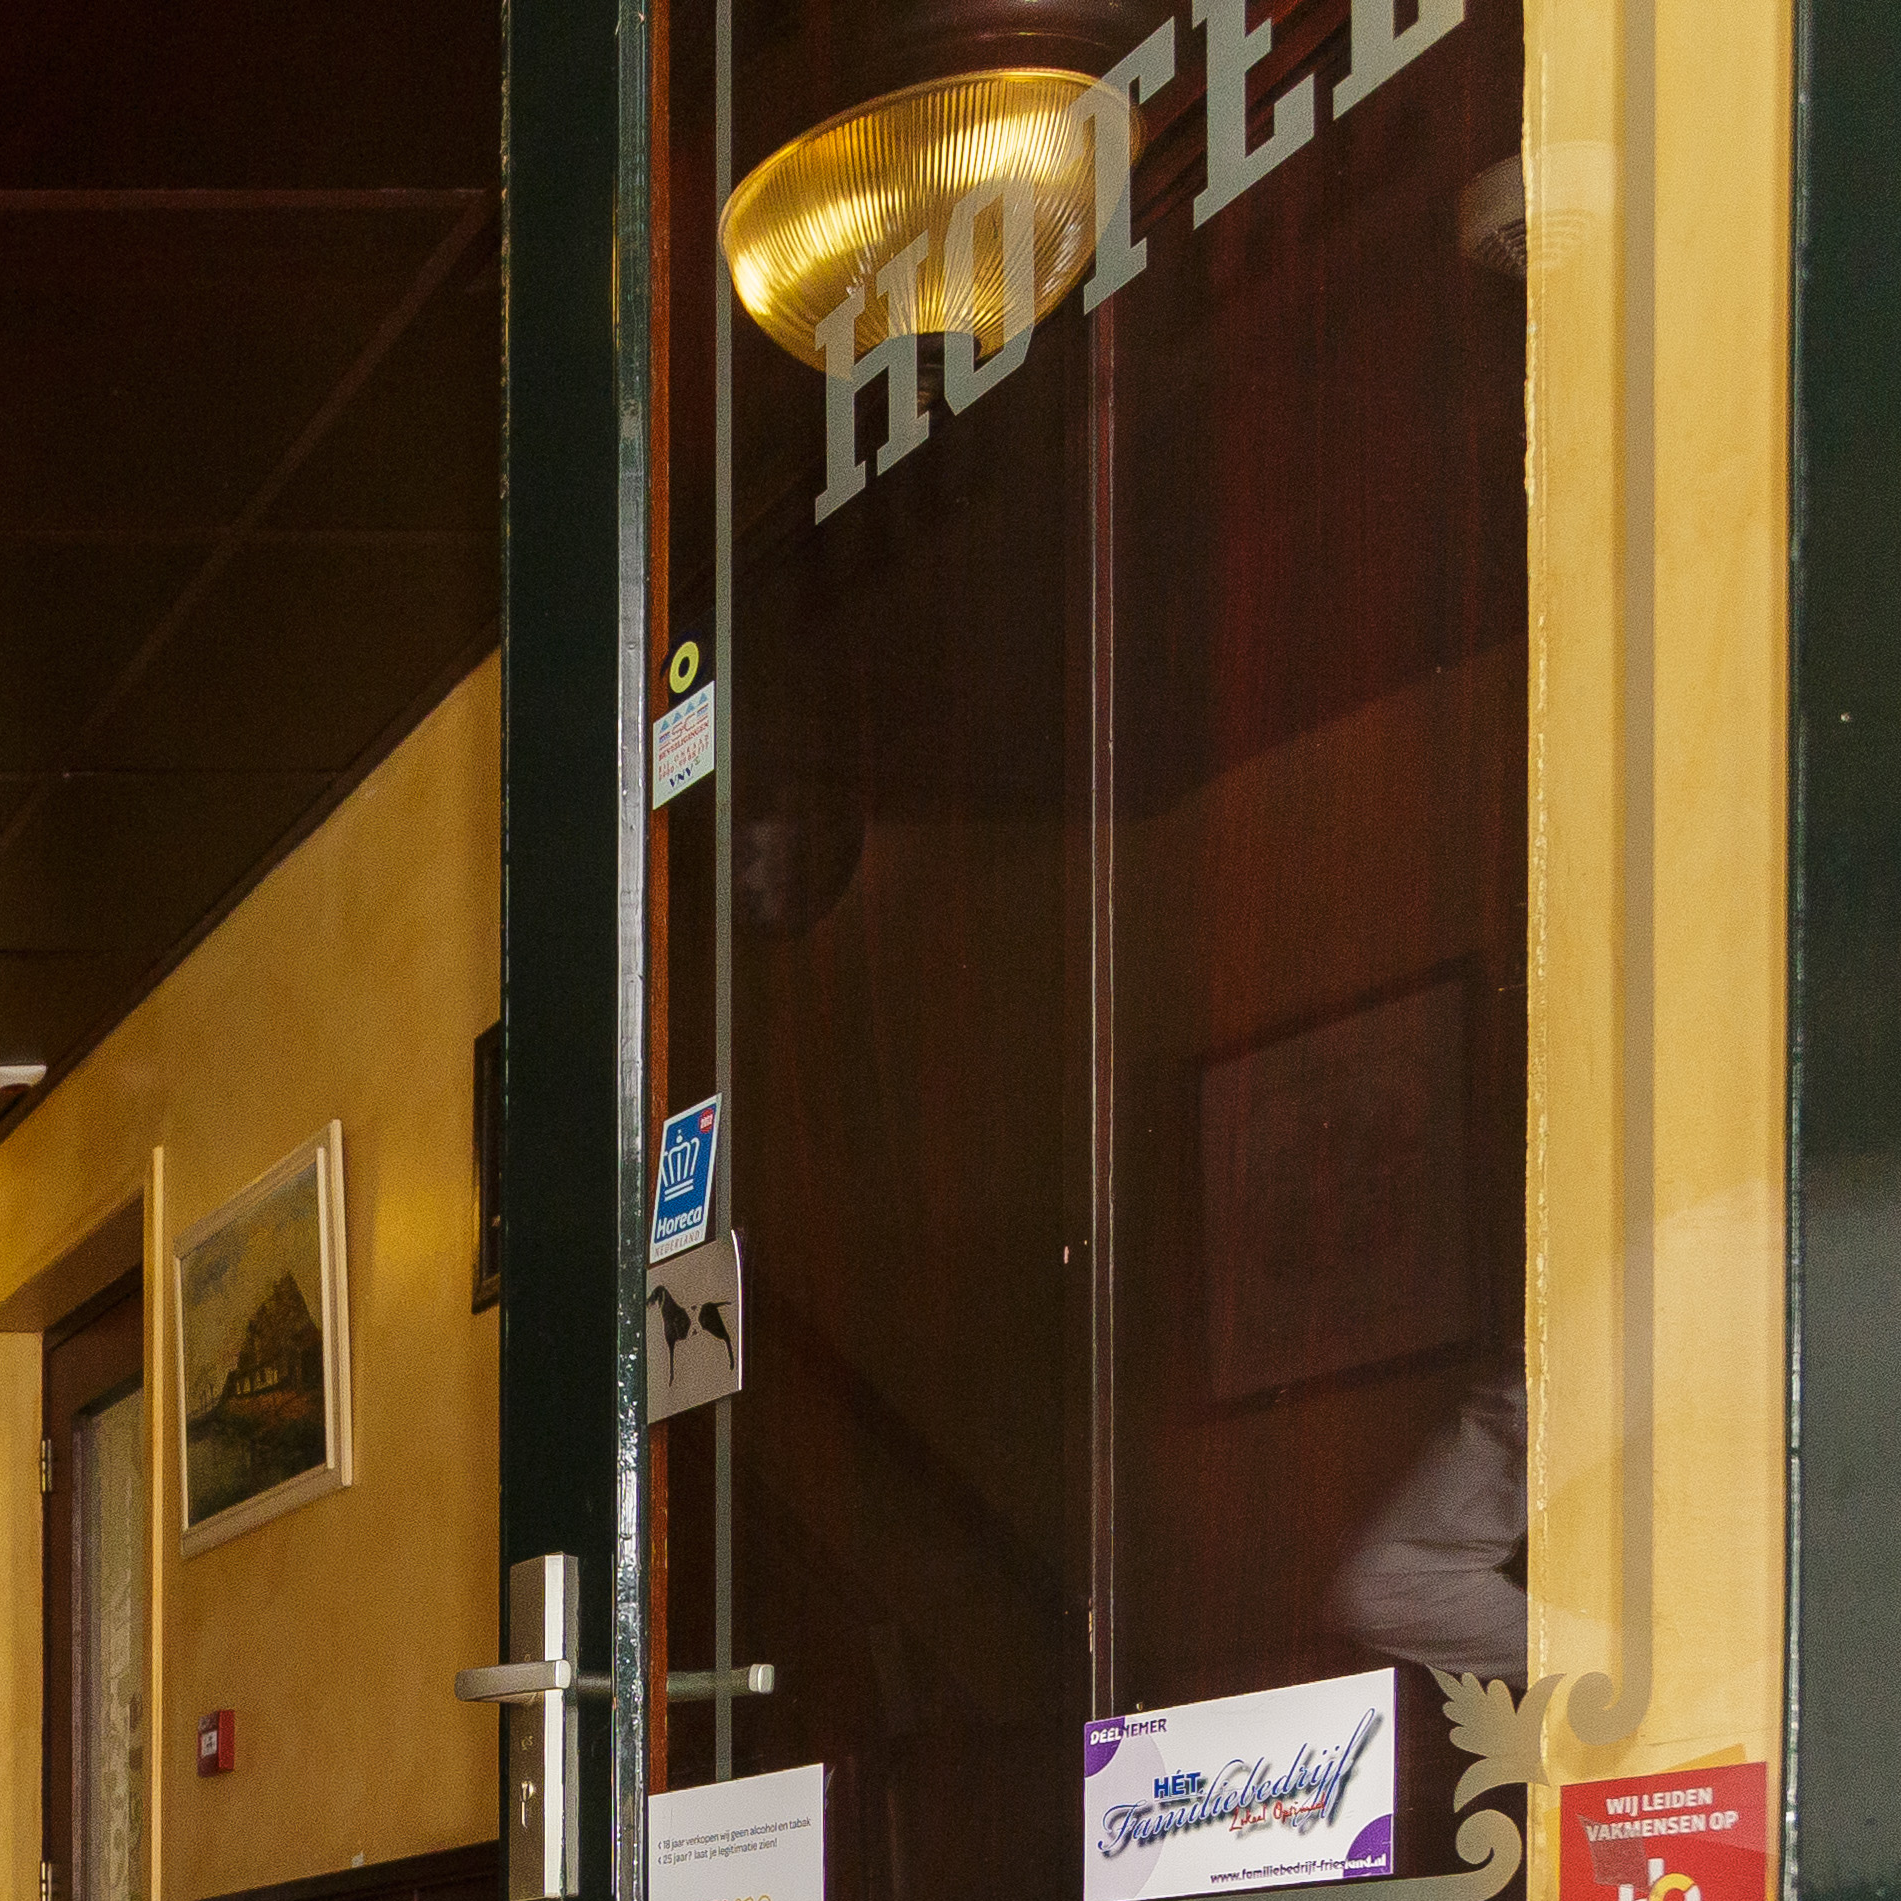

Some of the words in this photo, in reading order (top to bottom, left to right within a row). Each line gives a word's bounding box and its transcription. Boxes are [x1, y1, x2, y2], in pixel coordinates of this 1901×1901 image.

[656, 1205, 703, 1240] Horeca
[1089, 1718, 1168, 1745] DEELNEMER
[1097, 1707, 1376, 1852] Familiebedrijf
[1153, 1768, 1202, 1799] HÉT
[1605, 1795, 1640, 1817] WIJ
[1641, 1787, 1714, 1812] LEIDEN
[730, 1828, 749, 1841] geen
[750, 1822, 777, 1836] alcohol
[789, 1817, 812, 1829] tabak
[1584, 1813, 1706, 1842] VAKMENSEN
[1709, 1810, 1739, 1831] OP
[663, 1855, 672, 1865] 25
[1210, 1852, 1387, 1885] www.familiebedrijf-friesland.nl
